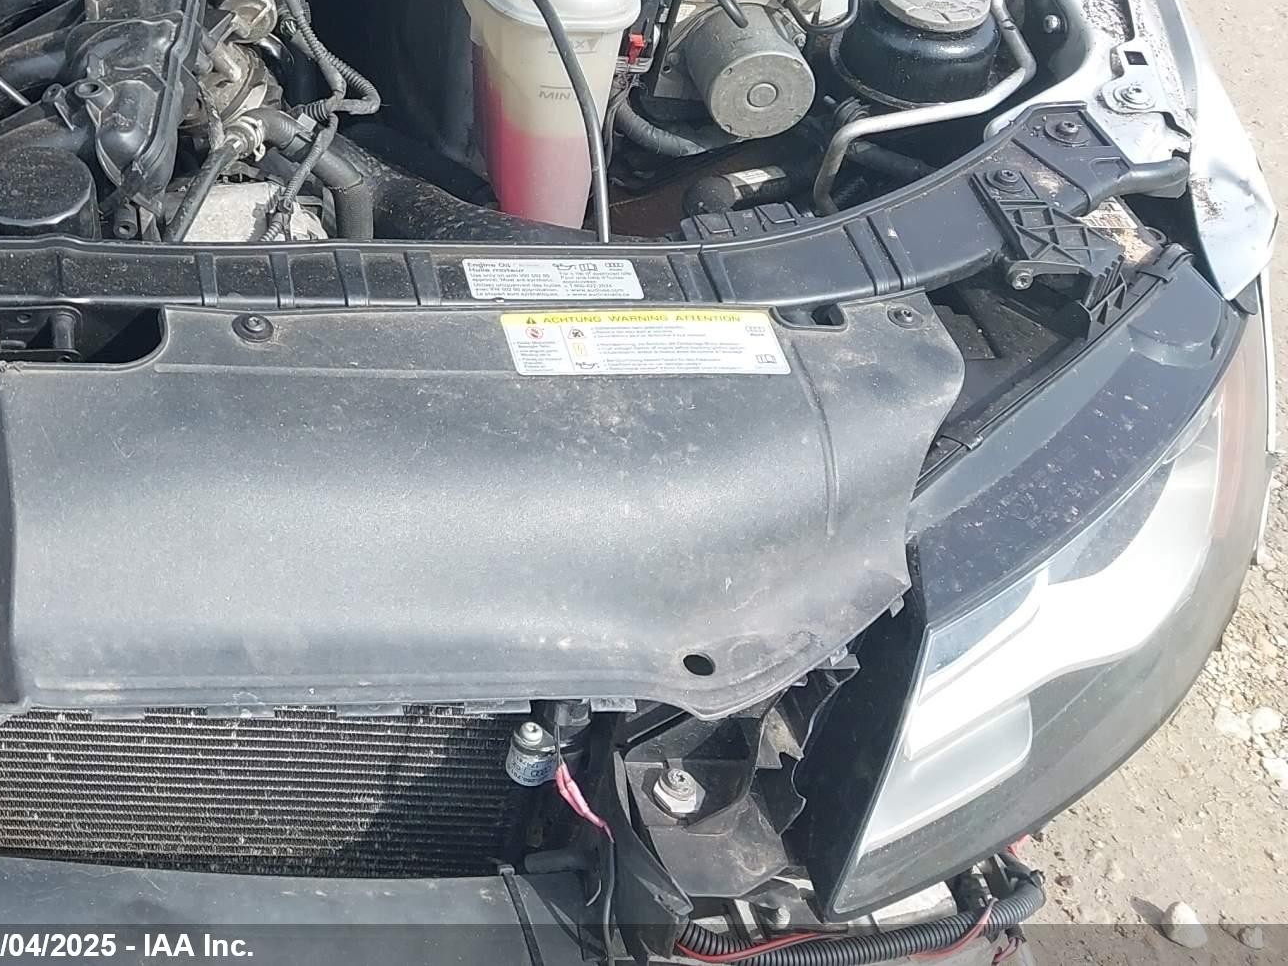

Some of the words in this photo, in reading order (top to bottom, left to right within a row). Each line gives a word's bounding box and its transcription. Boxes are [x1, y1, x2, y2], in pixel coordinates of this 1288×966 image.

[538, 90, 571, 101] MIN
[543, 316, 602, 324] ACHTUNG
[675, 314, 742, 322] ATTENTION
